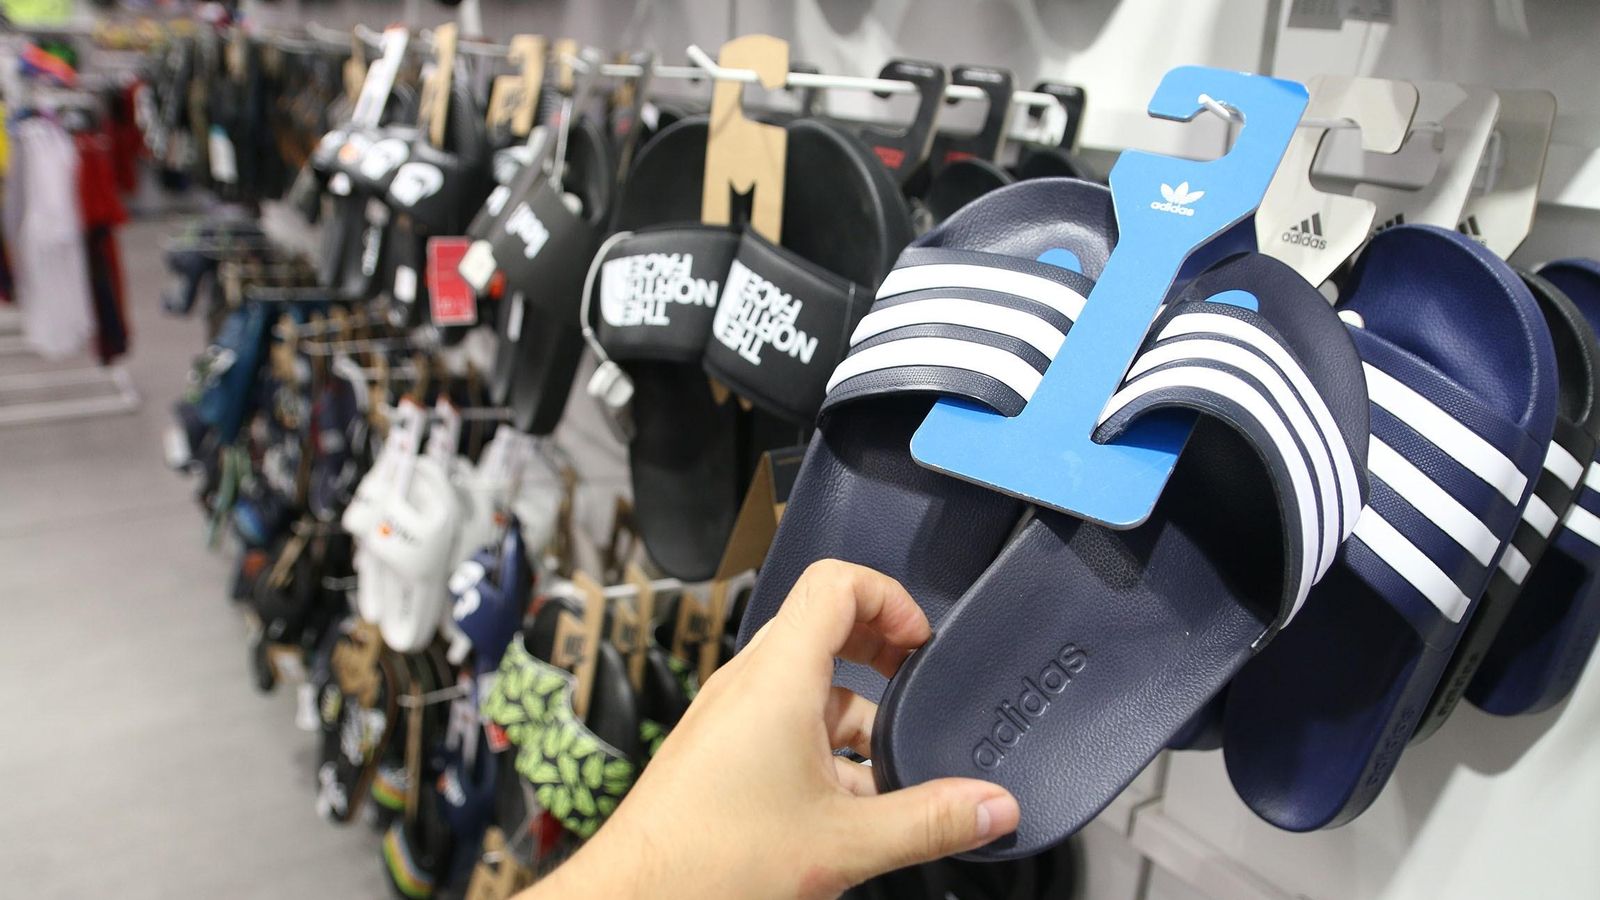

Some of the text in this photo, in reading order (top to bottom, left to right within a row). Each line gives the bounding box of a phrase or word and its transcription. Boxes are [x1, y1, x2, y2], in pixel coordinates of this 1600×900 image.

[1150, 201, 1195, 217] adidas
[1281, 229, 1328, 250] adidas
[628, 252, 693, 278] FACE
[626, 277, 719, 308] NORTH
[741, 271, 802, 323] FACE
[622, 301, 670, 326] THE
[720, 318, 764, 365] THE
[735, 298, 817, 363] NORTH
[972, 642, 1088, 772] adidas
